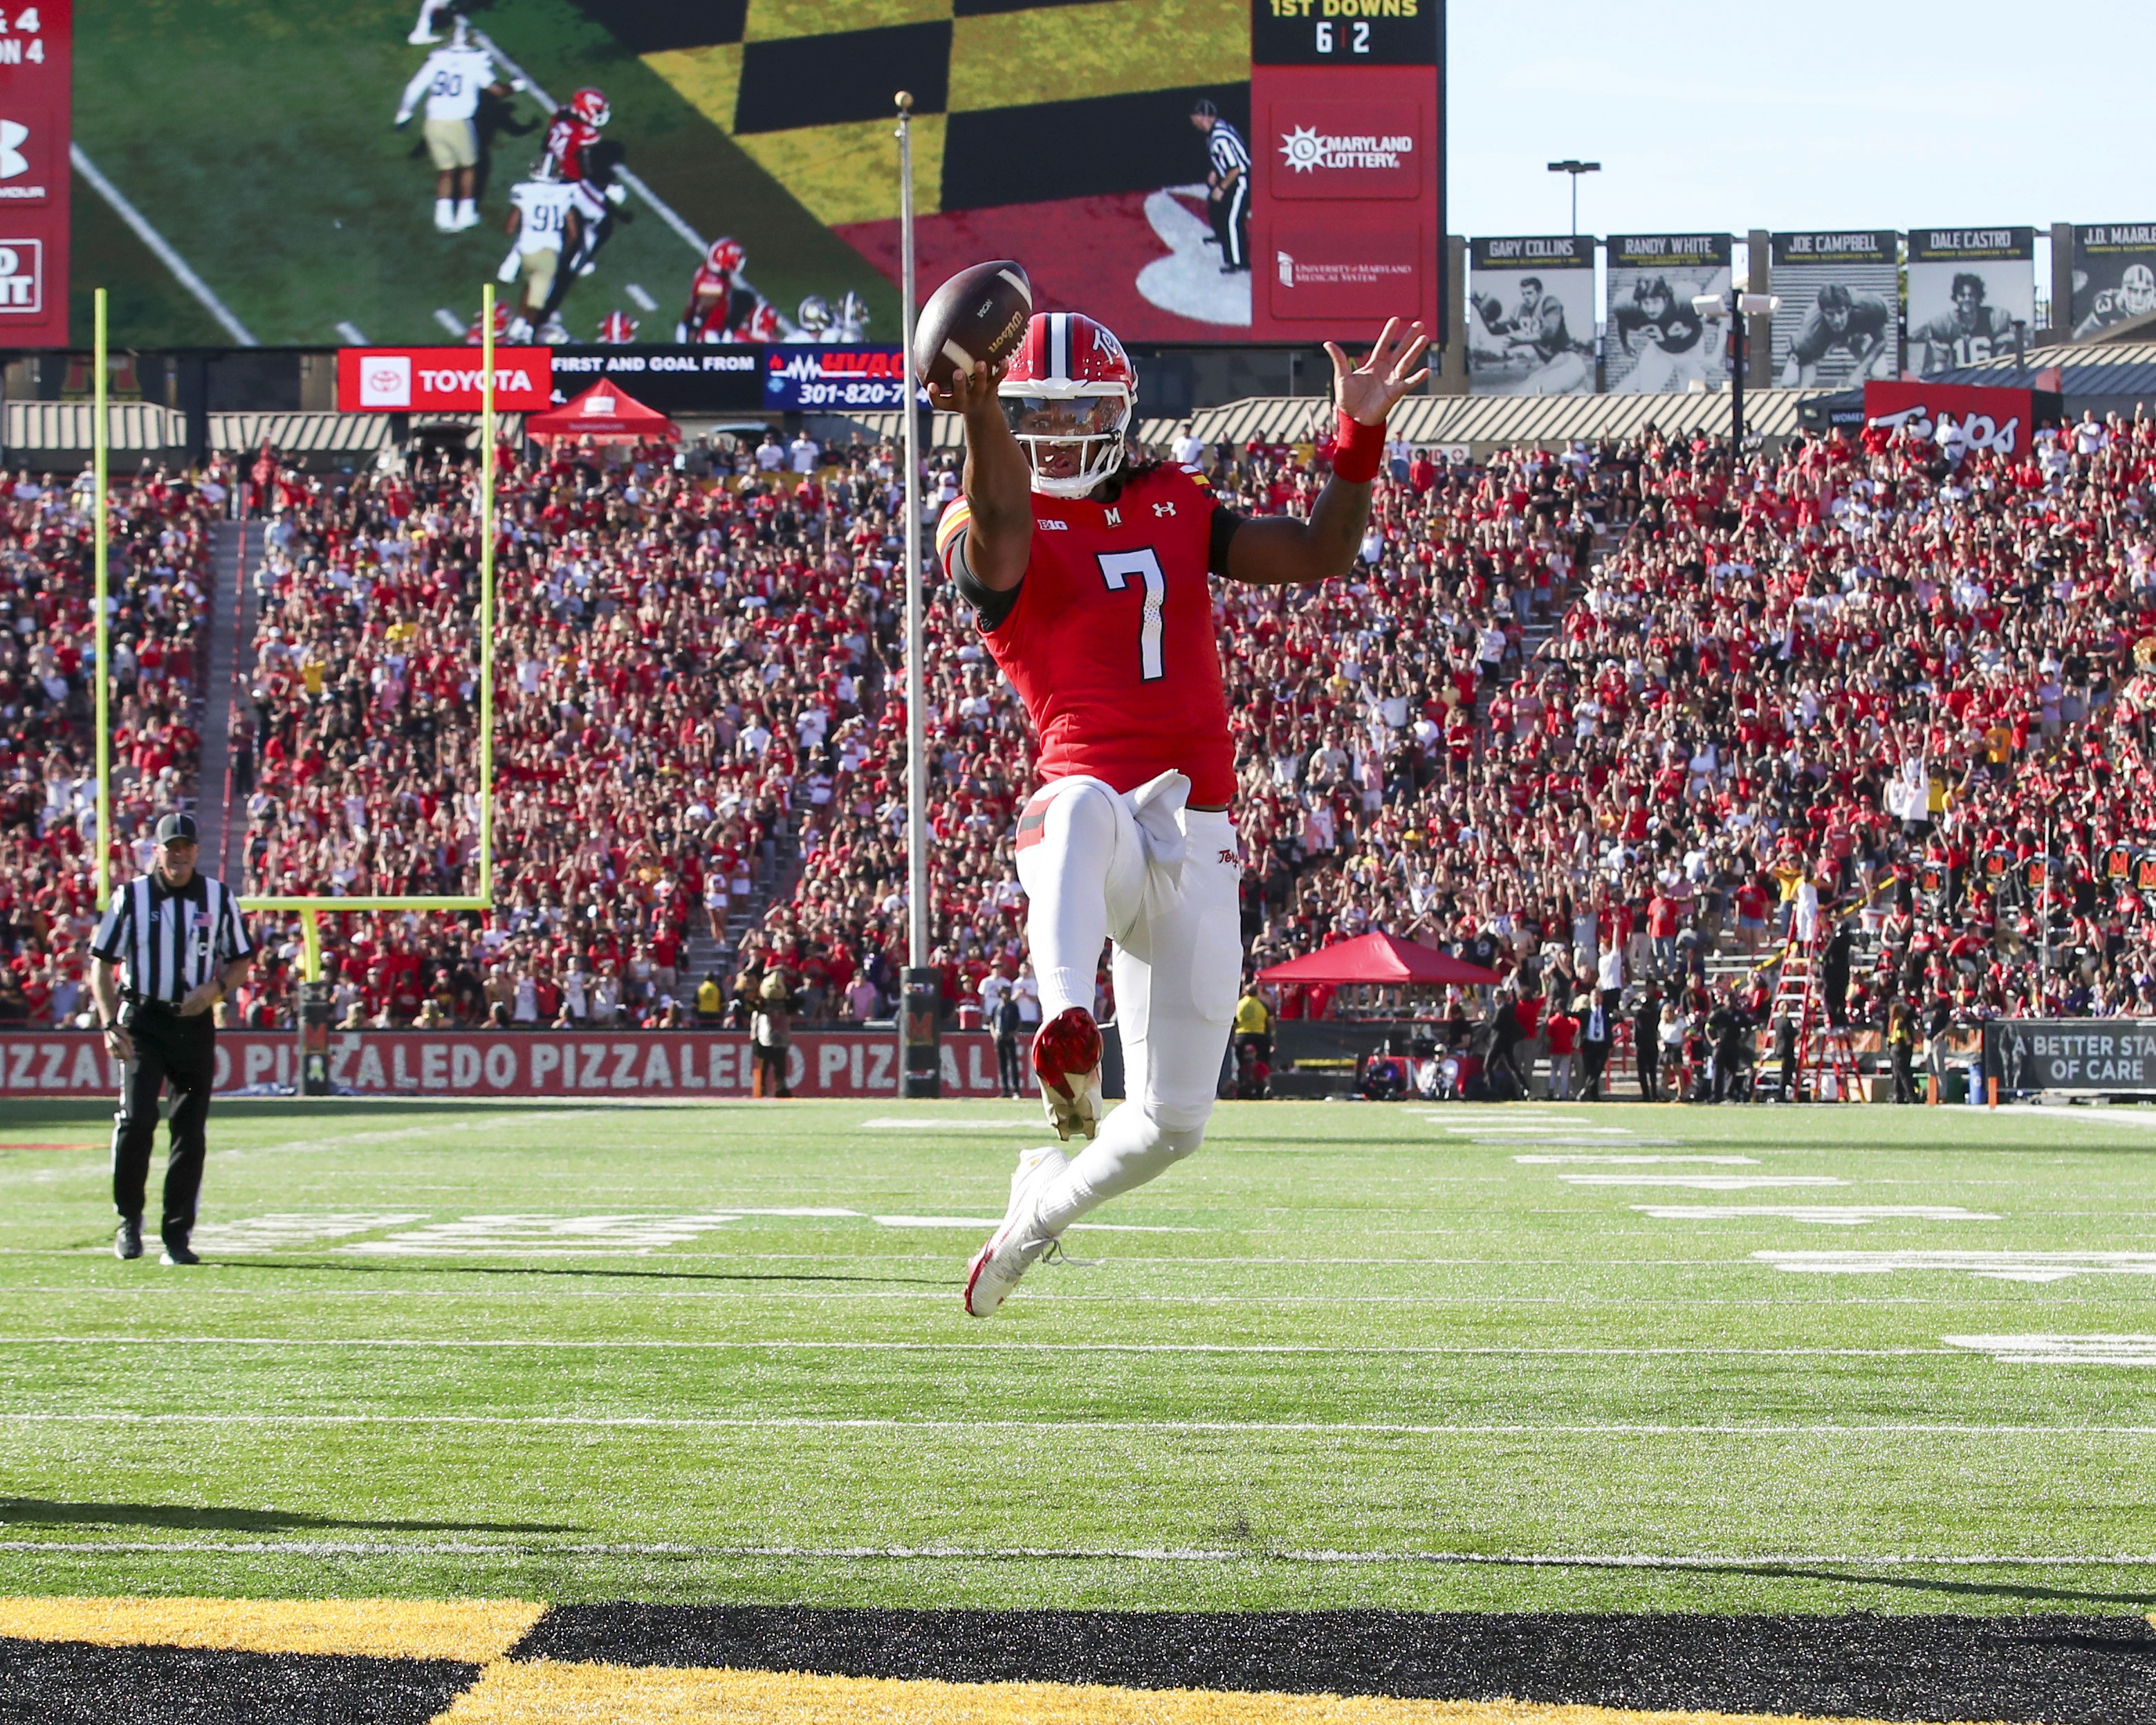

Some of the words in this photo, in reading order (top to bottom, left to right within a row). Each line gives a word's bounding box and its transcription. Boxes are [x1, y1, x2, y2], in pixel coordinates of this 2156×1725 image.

[1322, 0, 1418, 17] DOWNS
[1316, 21, 1333, 53] 6
[1352, 21, 1370, 53] 2
[25, 38, 45, 64] 4
[1326, 136, 1412, 152] MARYLAND
[533, 205, 564, 232] 91
[1489, 240, 1522, 257] GARY
[1524, 239, 1574, 257] COLLINS
[1625, 237, 1666, 255] RANDY
[1670, 237, 1713, 254] WHITE
[1789, 236, 1813, 252] JOE
[1815, 234, 1879, 252] CAMPBELL
[1930, 232, 1961, 249] DALE
[1963, 230, 2011, 248] CASTRO
[988, 311, 1024, 353] Wilson
[551, 356, 604, 372] FIRST
[606, 356, 646, 372] AND
[649, 356, 699, 371] GOAL
[702, 356, 755, 371] FROM
[1103, 507, 1122, 526] M
[1096, 546, 1165, 682] 7
[2033, 1035, 2114, 1055] BETTER
[2049, 1059, 2081, 1080] OF
[2085, 1059, 2144, 1080] CARE
